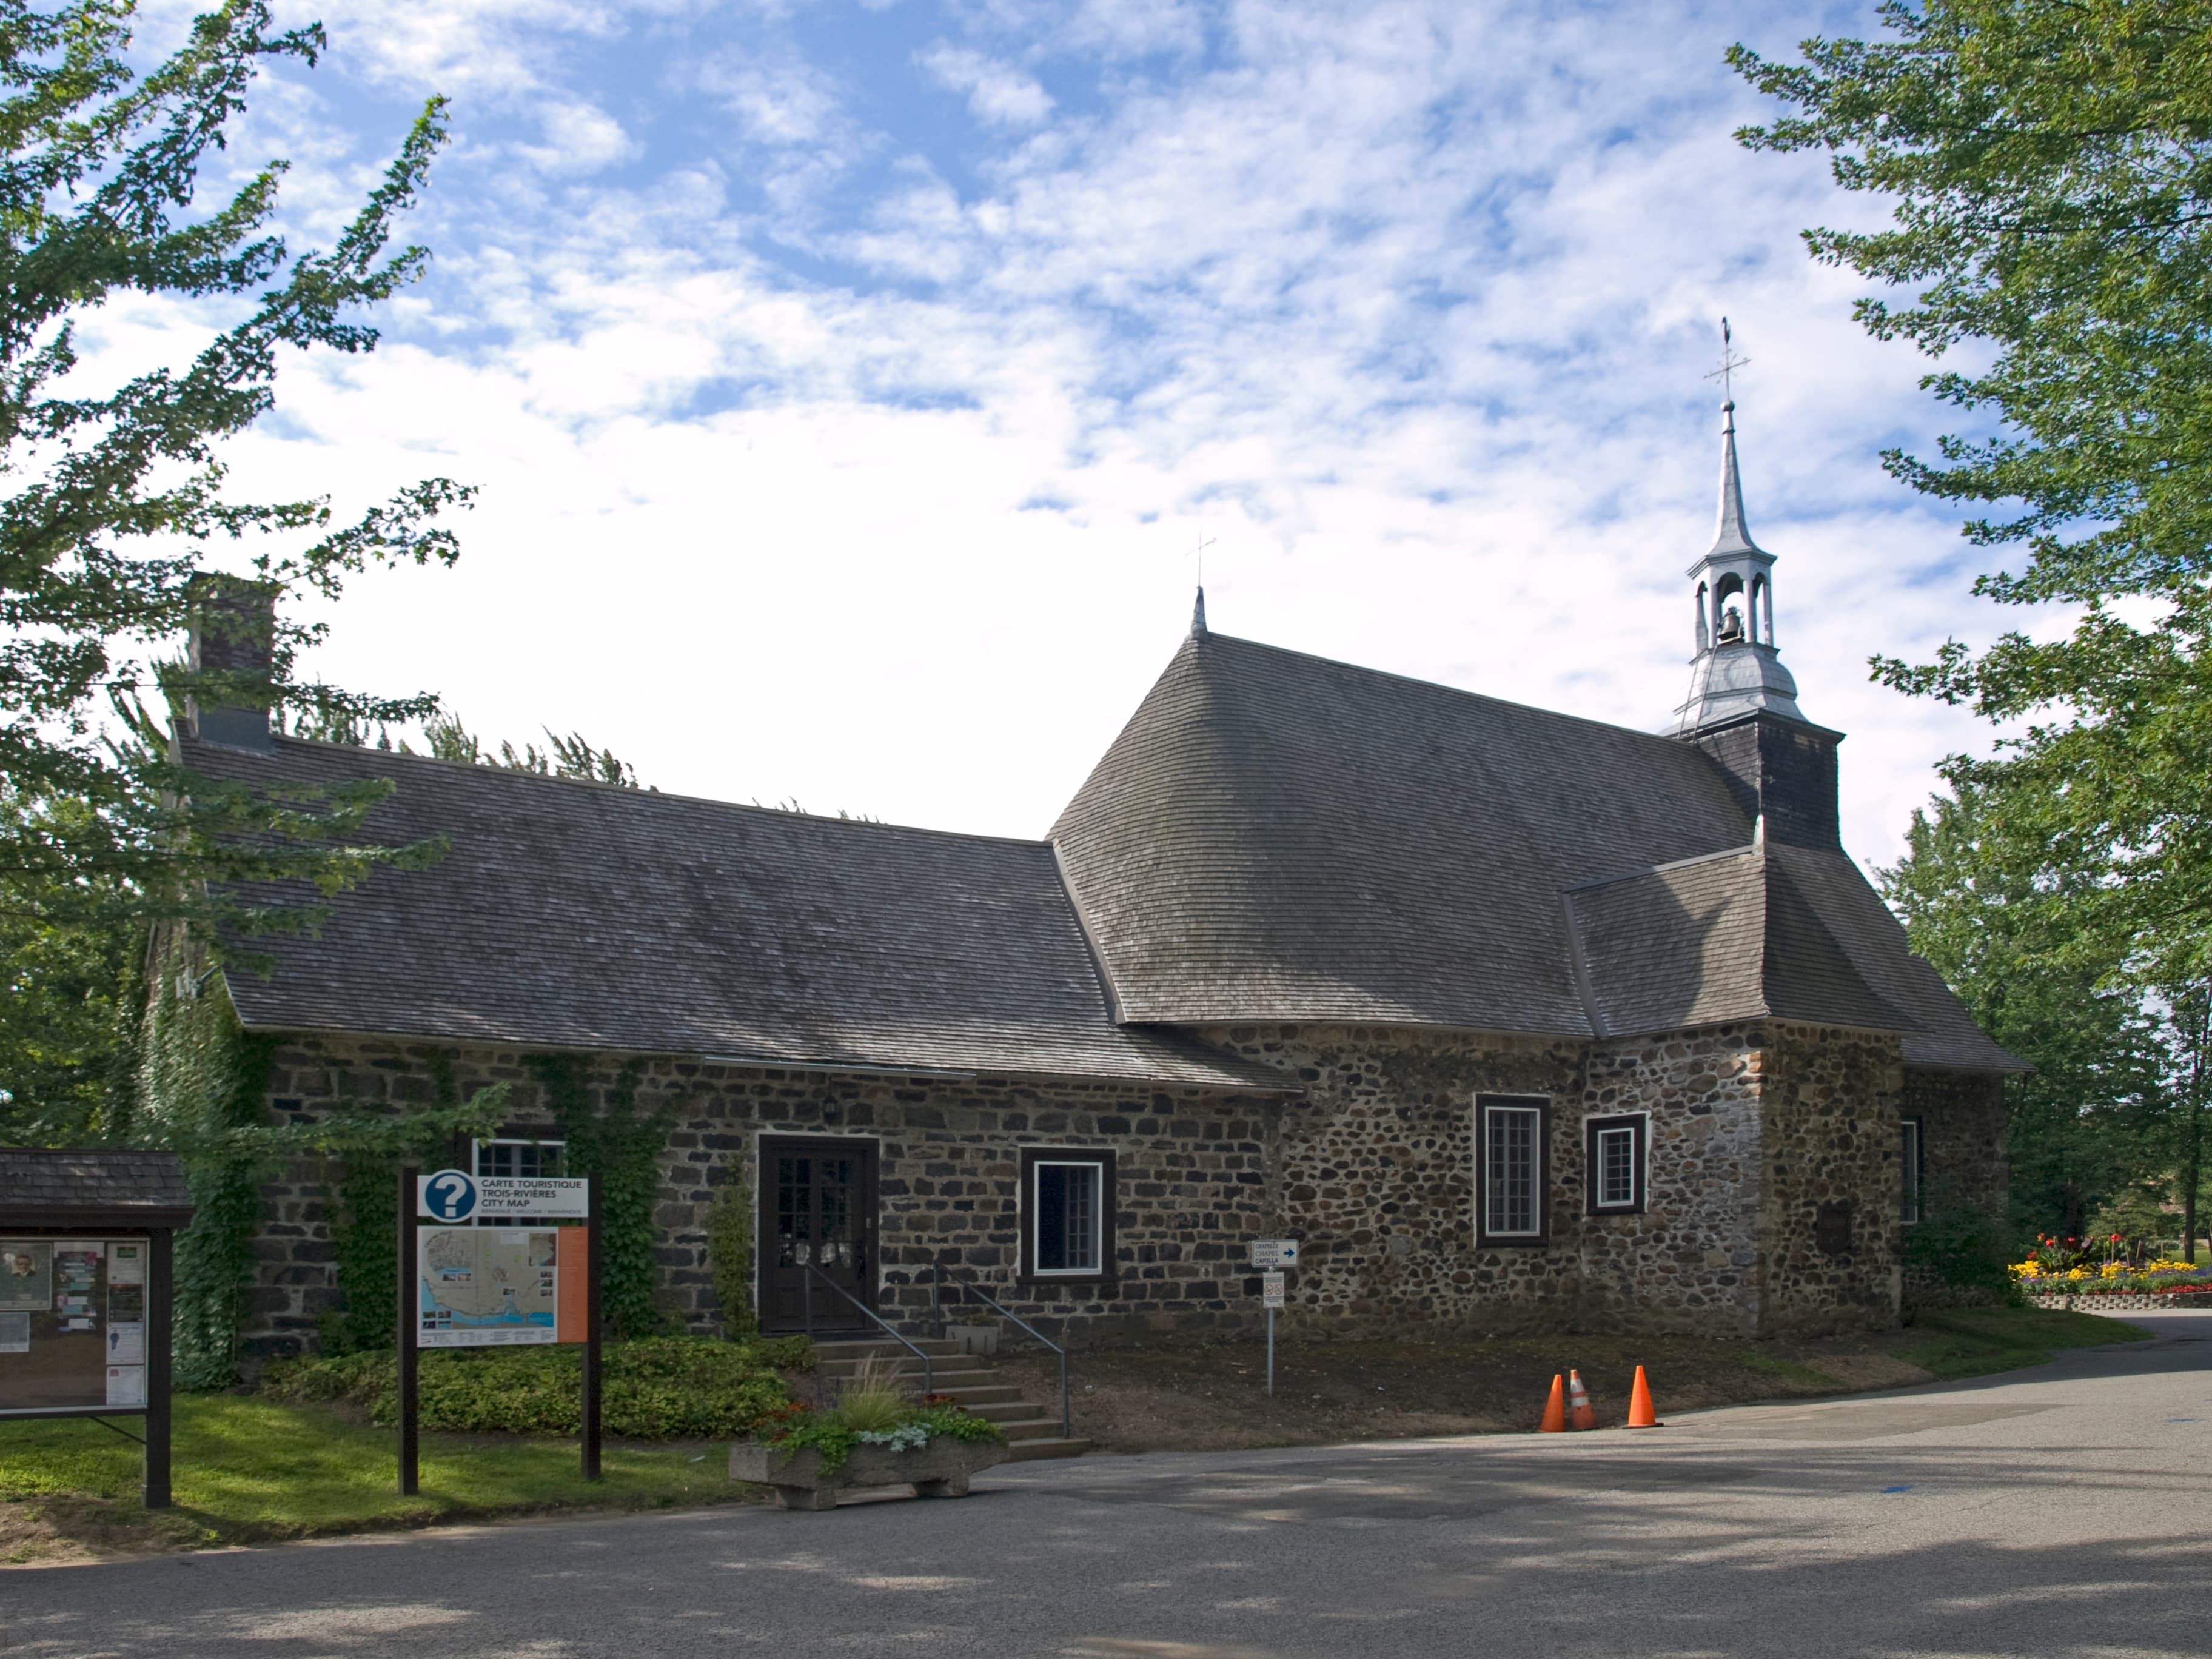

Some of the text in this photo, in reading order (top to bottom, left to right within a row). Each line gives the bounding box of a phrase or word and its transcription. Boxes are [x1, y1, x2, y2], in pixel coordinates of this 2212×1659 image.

[481, 1179, 514, 1188] CARTE
[481, 1188, 557, 1198] TROIS-RIVIÈRES
[481, 1199, 503, 1207] CITY
